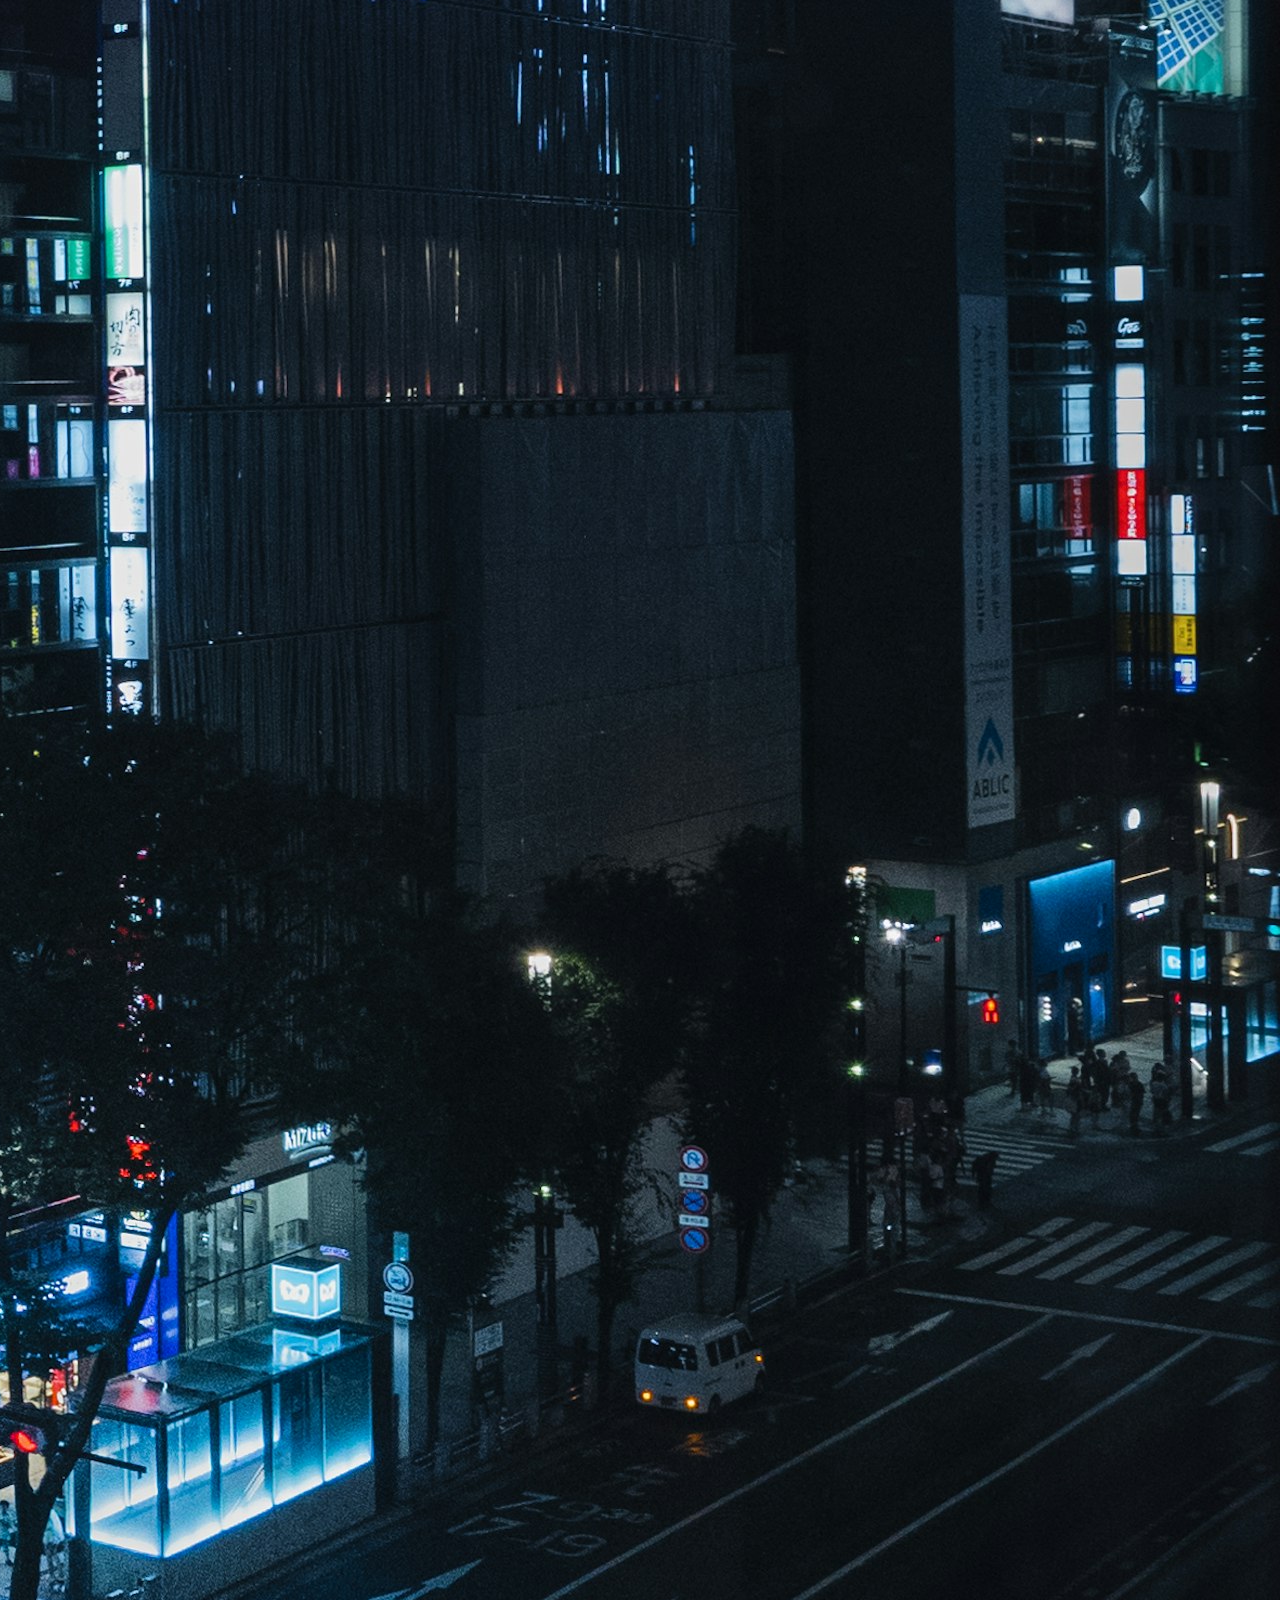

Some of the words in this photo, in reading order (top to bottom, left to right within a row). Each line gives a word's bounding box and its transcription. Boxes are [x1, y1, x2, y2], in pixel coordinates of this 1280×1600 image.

[118, 279, 132, 287] 7F
[124, 661, 138, 669] 4F
[973, 774, 1009, 800] ABLIC
